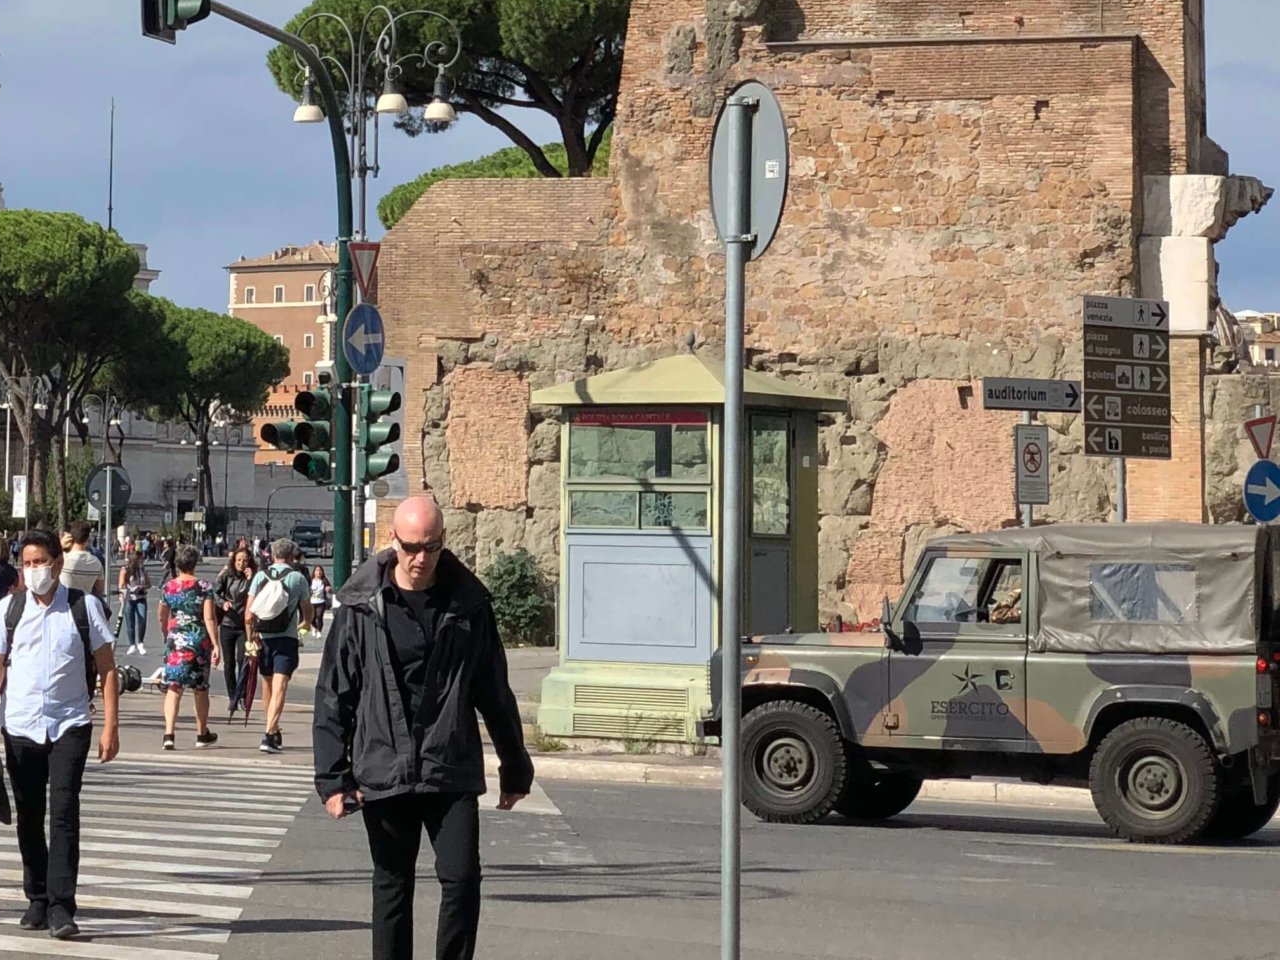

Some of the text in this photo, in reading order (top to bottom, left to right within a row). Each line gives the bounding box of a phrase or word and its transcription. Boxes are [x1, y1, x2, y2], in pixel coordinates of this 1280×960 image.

[1086, 300, 1108, 310] piazza
[1086, 312, 1113, 322] venezia
[1086, 331, 1109, 341] piazza
[987, 385, 1047, 401] auditorium
[1127, 403, 1168, 417] colosseo
[930, 700, 1010, 716] ESERCITO
